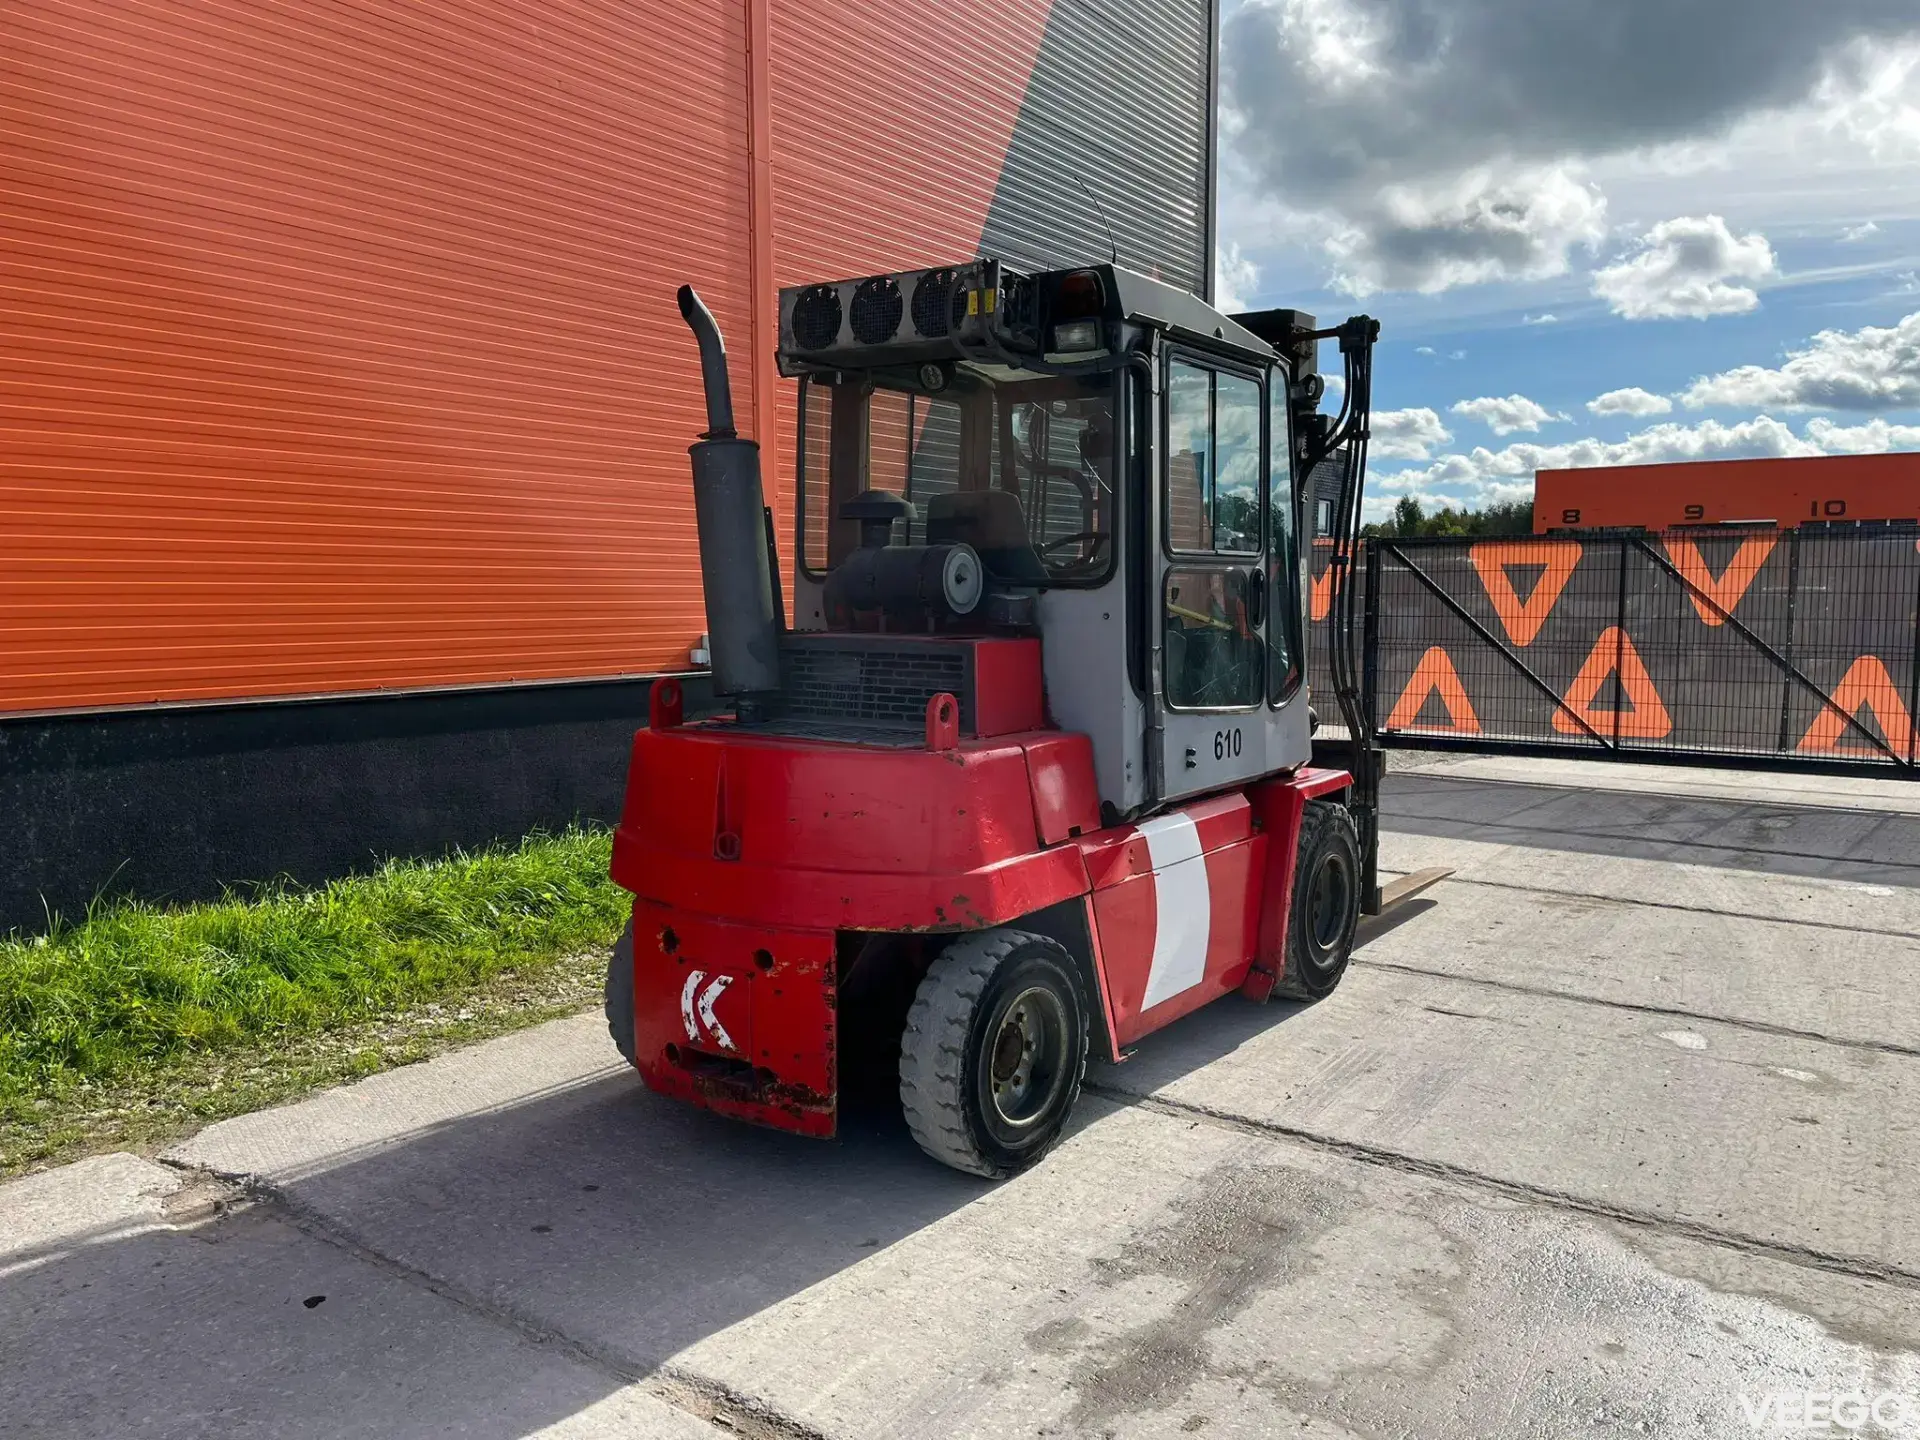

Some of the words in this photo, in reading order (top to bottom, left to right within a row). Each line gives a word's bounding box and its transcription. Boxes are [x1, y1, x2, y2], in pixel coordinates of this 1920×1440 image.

[1562, 508, 1581, 524] 8
[1684, 504, 1704, 520] 9
[1811, 500, 1846, 517] 10
[1214, 728, 1242, 760] 610
